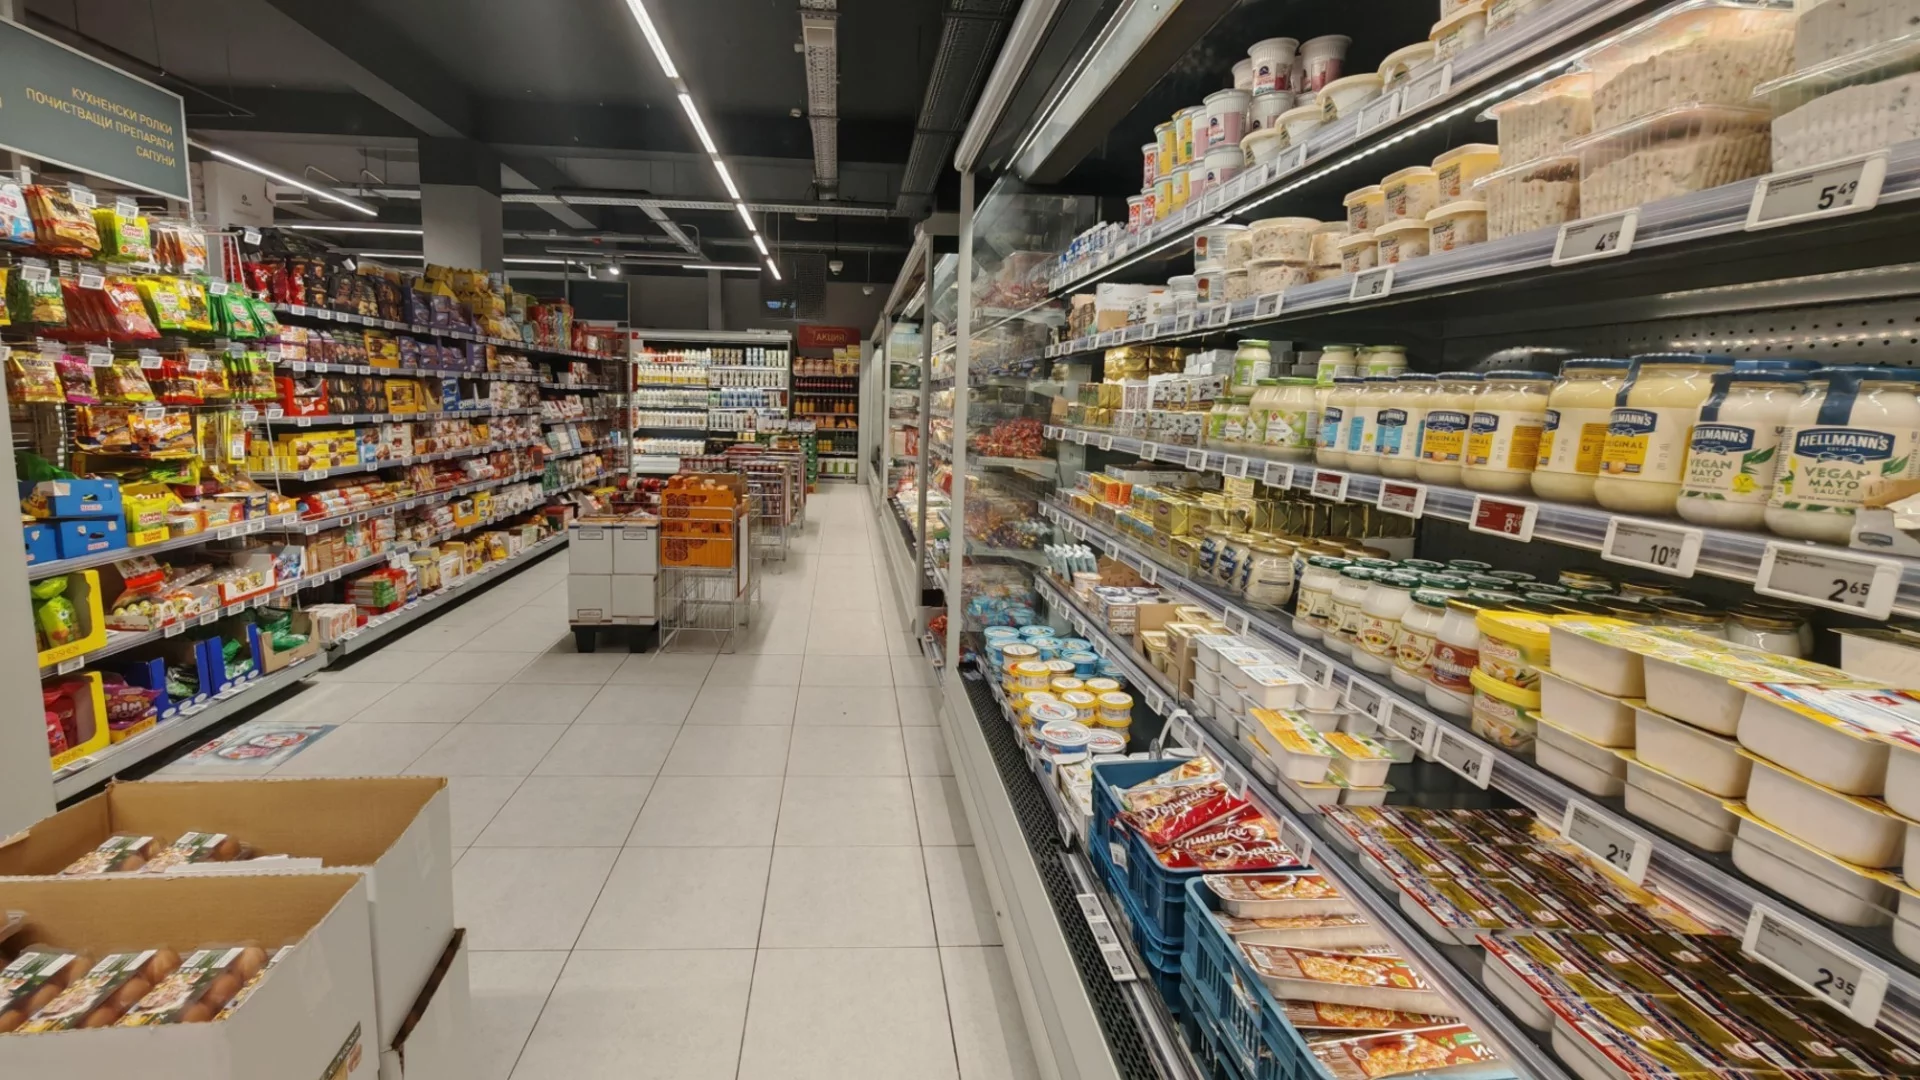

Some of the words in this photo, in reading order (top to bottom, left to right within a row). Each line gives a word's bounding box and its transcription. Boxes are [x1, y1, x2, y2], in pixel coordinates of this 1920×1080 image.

[71, 87, 137, 122] КУХНЕНСКИ
[139, 113, 173, 136] РОЛКИ
[25, 87, 114, 129] ПОЧИСТВАЩИ
[115, 121, 175, 152] ПРЕПАРАТИ
[135, 145, 176, 168] САПУНИ
[816, 332, 845, 342] АКЦИЯ
[1799, 434, 1889, 451] HELLMANN'S
[1690, 458, 1733, 470] VEGAN
[1691, 469, 1723, 478] MAYO
[1808, 479, 1859, 490] MAYO
[1813, 487, 1852, 497] SAUCE
